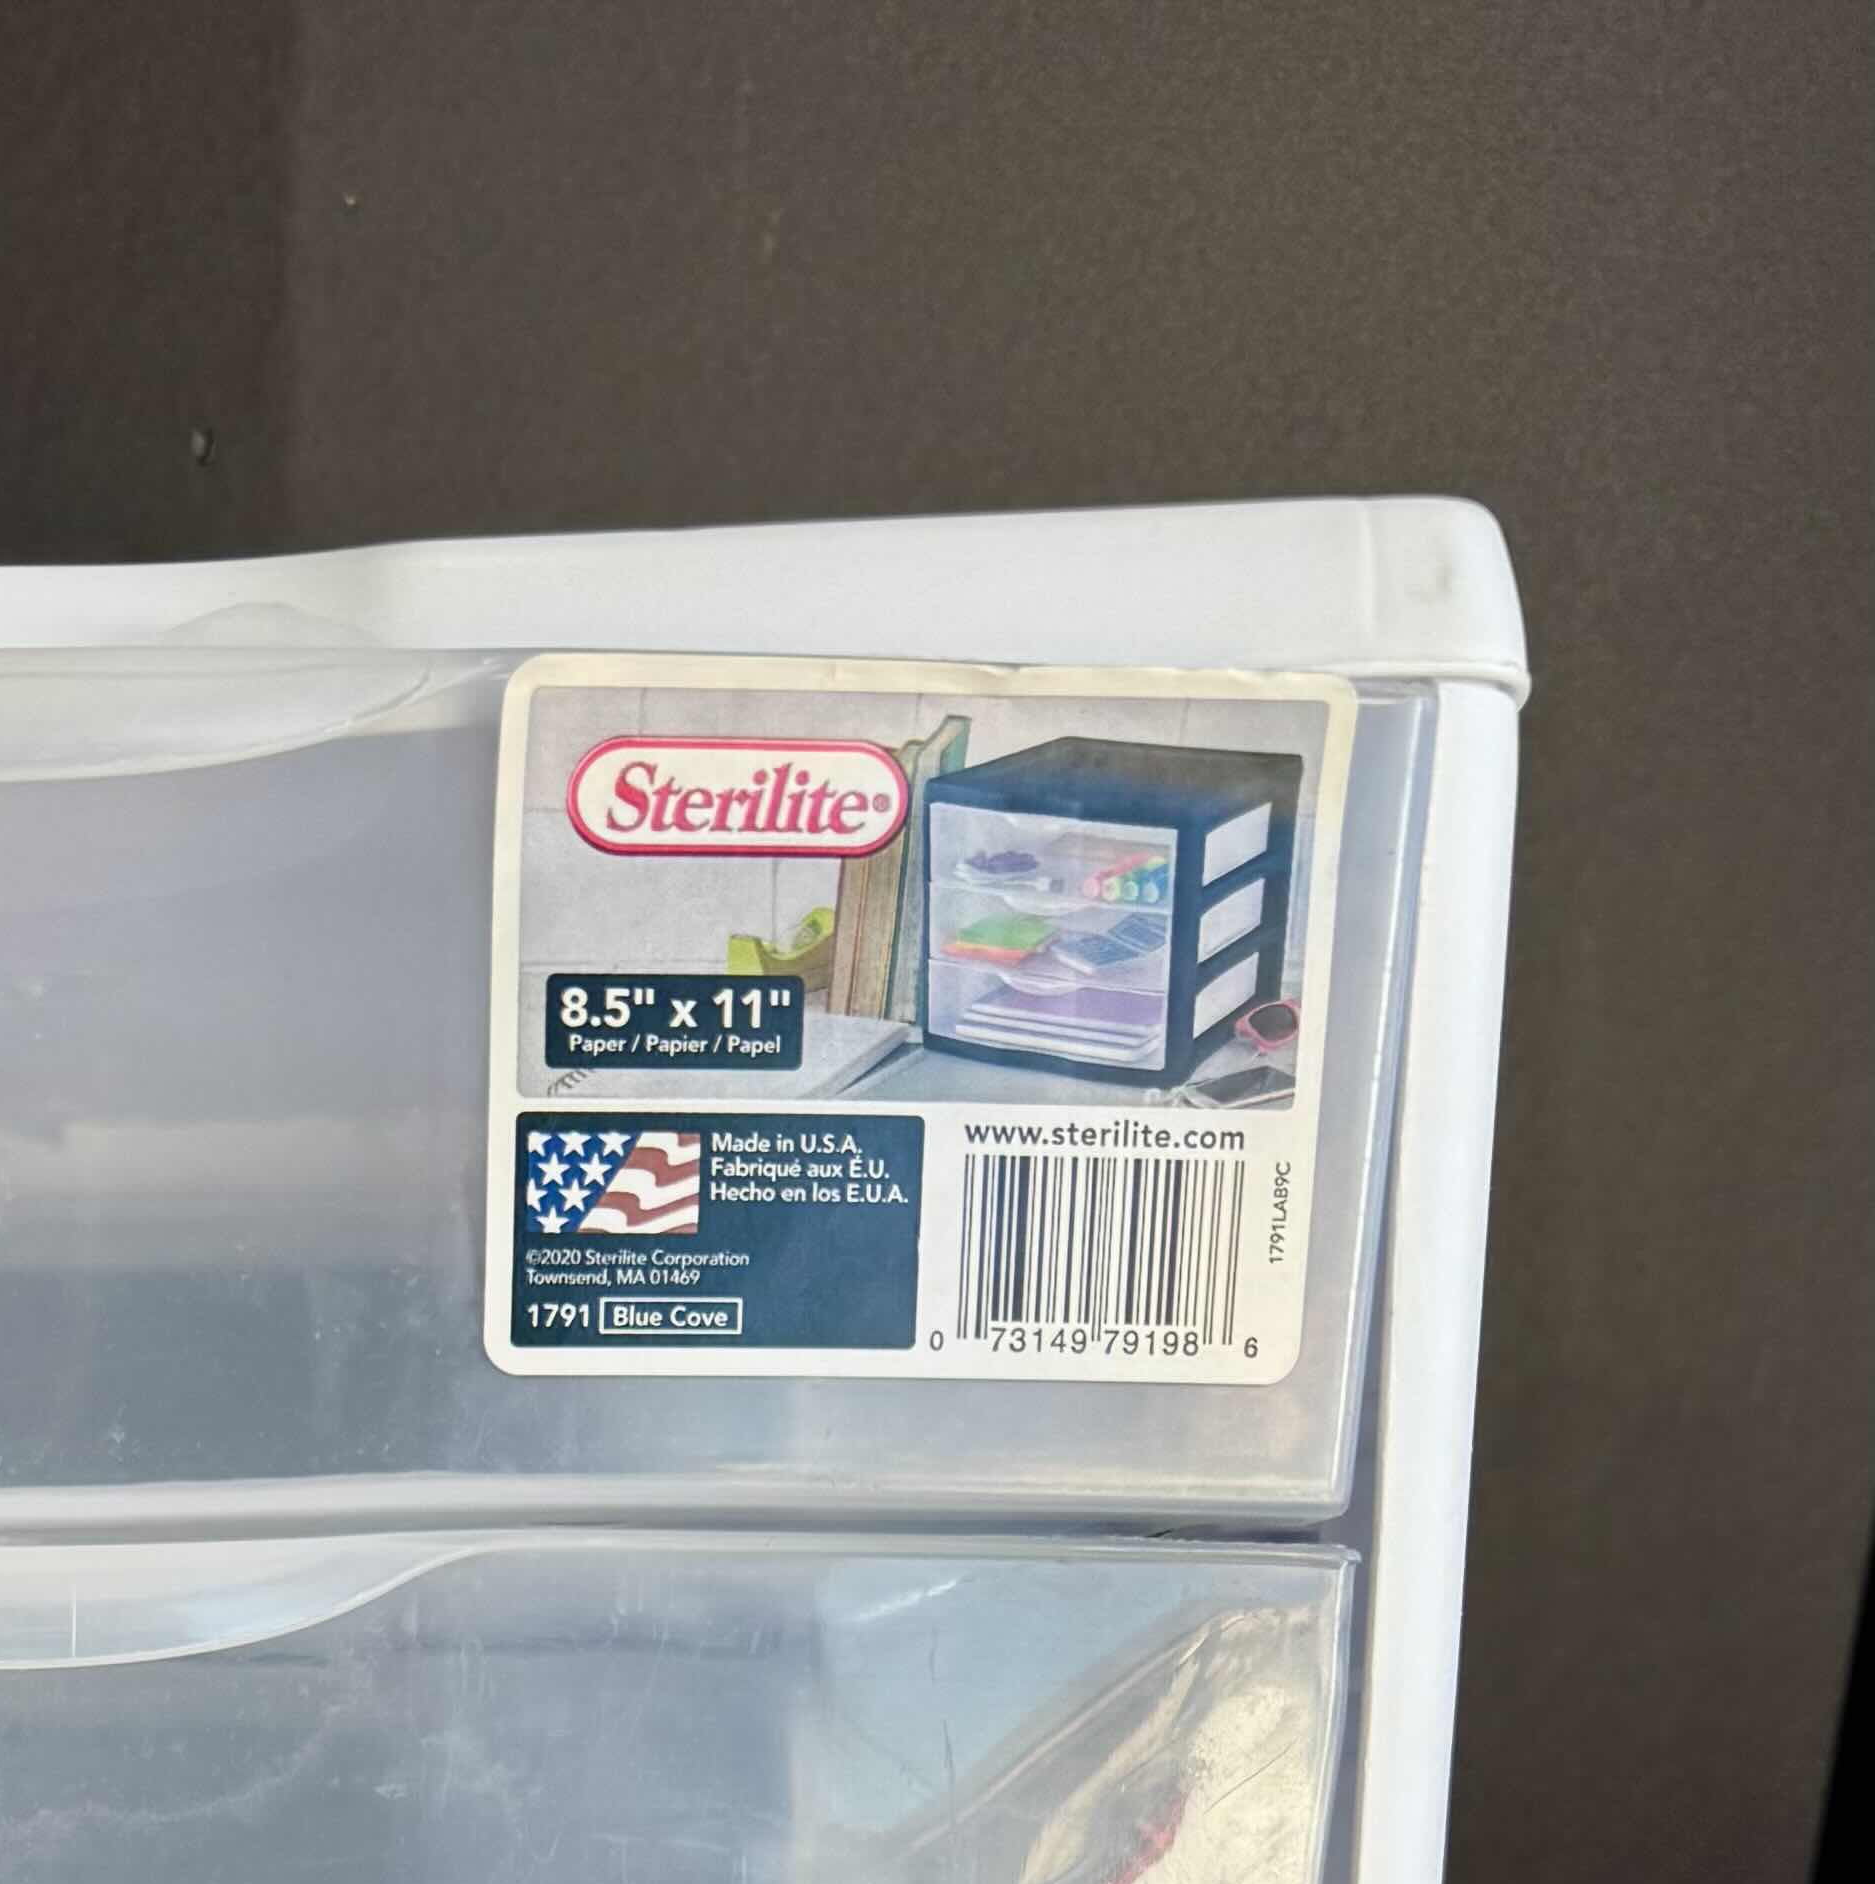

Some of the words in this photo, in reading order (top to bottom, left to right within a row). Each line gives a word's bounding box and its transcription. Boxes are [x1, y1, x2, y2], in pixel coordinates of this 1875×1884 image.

[560, 988, 655, 1027] 8.5"
[670, 1000, 697, 1027] x
[714, 989, 791, 1029] 11"
[569, 1035, 627, 1056] Paper
[631, 1035, 640, 1053] /
[646, 1035, 710, 1057] Papier
[712, 1036, 722, 1054] /
[728, 1037, 781, 1057] Papel
[712, 1133, 772, 1153] Made
[777, 1134, 795, 1153] in
[800, 1134, 862, 1154] U.S.A.
[965, 1120, 1244, 1150] www.sterilite.com
[711, 1157, 801, 1182] Fabriqué
[807, 1163, 843, 1178] aux
[710, 1184, 776, 1202] Hecho
[781, 1188, 806, 1202] en
[813, 1184, 841, 1203] los
[847, 1185, 908, 1204] E.U.A.
[1269, 1161, 1291, 1264] 1791LAB9C
[585, 1251, 647, 1266] Sterilite
[652, 1251, 750, 1269] Corporation
[526, 1270, 612, 1287] Townsend,
[617, 1271, 645, 1284] MA
[650, 1271, 701, 1286] 01469
[527, 1304, 590, 1328] 1791
[613, 1307, 663, 1327] Blue
[670, 1307, 728, 1327] Cove
[930, 1331, 944, 1351] 0
[991, 1328, 1087, 1353] 73149
[1105, 1330, 1199, 1356] 79198
[1245, 1337, 1258, 1358] 6
